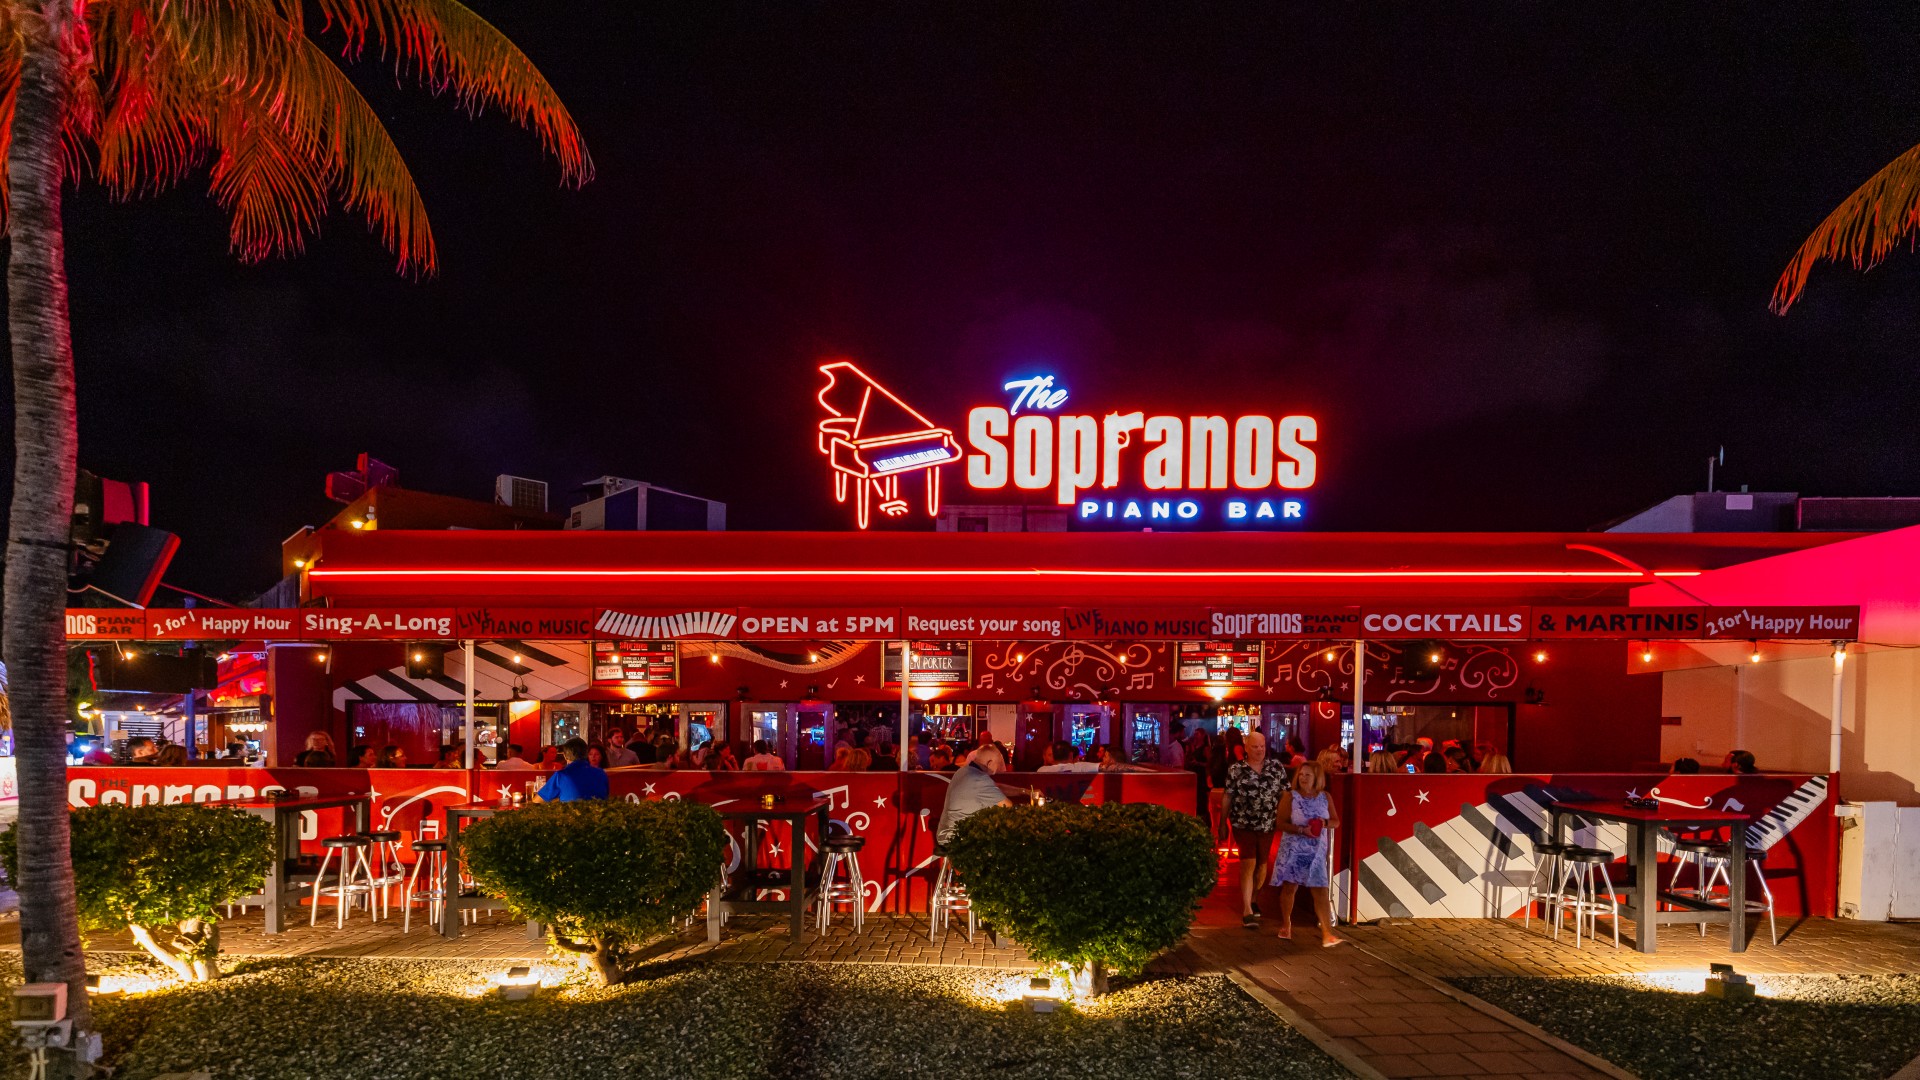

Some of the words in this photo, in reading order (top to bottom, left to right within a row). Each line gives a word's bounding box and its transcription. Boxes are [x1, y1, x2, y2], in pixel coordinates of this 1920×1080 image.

[1004, 375, 1068, 416] The
[967, 406, 1318, 505] Sopranos
[1081, 501, 1199, 518] PIANO
[1228, 501, 1302, 518] BAR
[153, 623, 165, 636] 2
[165, 614, 188, 631] for
[202, 616, 250, 635] Happy
[254, 615, 292, 630] Hour
[305, 613, 452, 636] Sing-A-Long
[457, 607, 493, 629] LIVE
[481, 620, 533, 635] PIANO
[539, 620, 590, 635] MUSIC
[742, 616, 809, 634] OPEN
[816, 617, 840, 633] at
[845, 616, 894, 633] 5PM
[908, 615, 975, 636] Request
[979, 619, 1019, 636] your
[1022, 619, 1061, 637] song
[1066, 608, 1102, 631] LIVE
[1211, 612, 1302, 639] Sopranos
[1303, 614, 1359, 623] PIANO
[1363, 613, 1523, 632] COCKTAILS
[1538, 613, 1557, 632] &
[1566, 613, 1699, 632] MARTINIS
[1705, 621, 1719, 636] 2
[1717, 613, 1743, 631] for
[1751, 614, 1805, 634] Happy
[1809, 614, 1853, 630] Hour
[97, 626, 132, 634] BAR
[1094, 620, 1149, 636] PIANO
[1154, 620, 1208, 636] MUSIC
[1303, 625, 1342, 634] BAR
[923, 657, 953, 670] PORTER
[100, 779, 129, 788] THE
